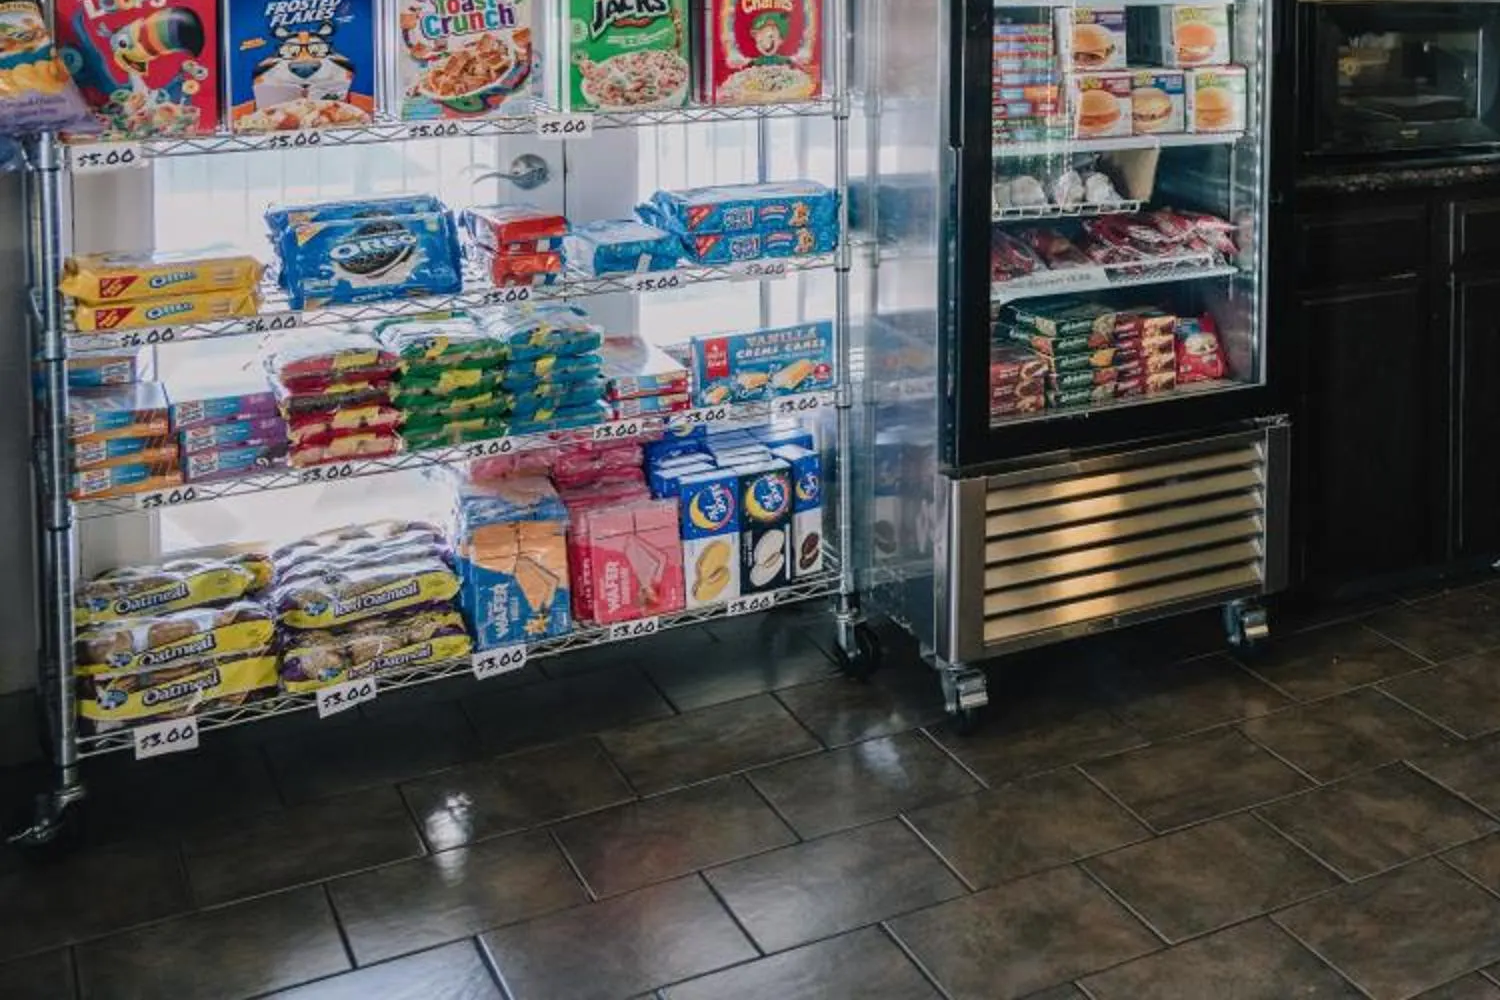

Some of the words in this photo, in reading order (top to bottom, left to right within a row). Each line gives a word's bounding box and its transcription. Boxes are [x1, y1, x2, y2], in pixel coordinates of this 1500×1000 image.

[269, 7, 335, 28] FLAKES
[422, 2, 515, 37] Crunch
[78, 149, 135, 168] $5.00
[114, 582, 190, 615] Oatmeal
[363, 580, 419, 608] Oatmeal
[139, 632, 216, 664] Oatmeal
[143, 668, 220, 706] Oatmeal
